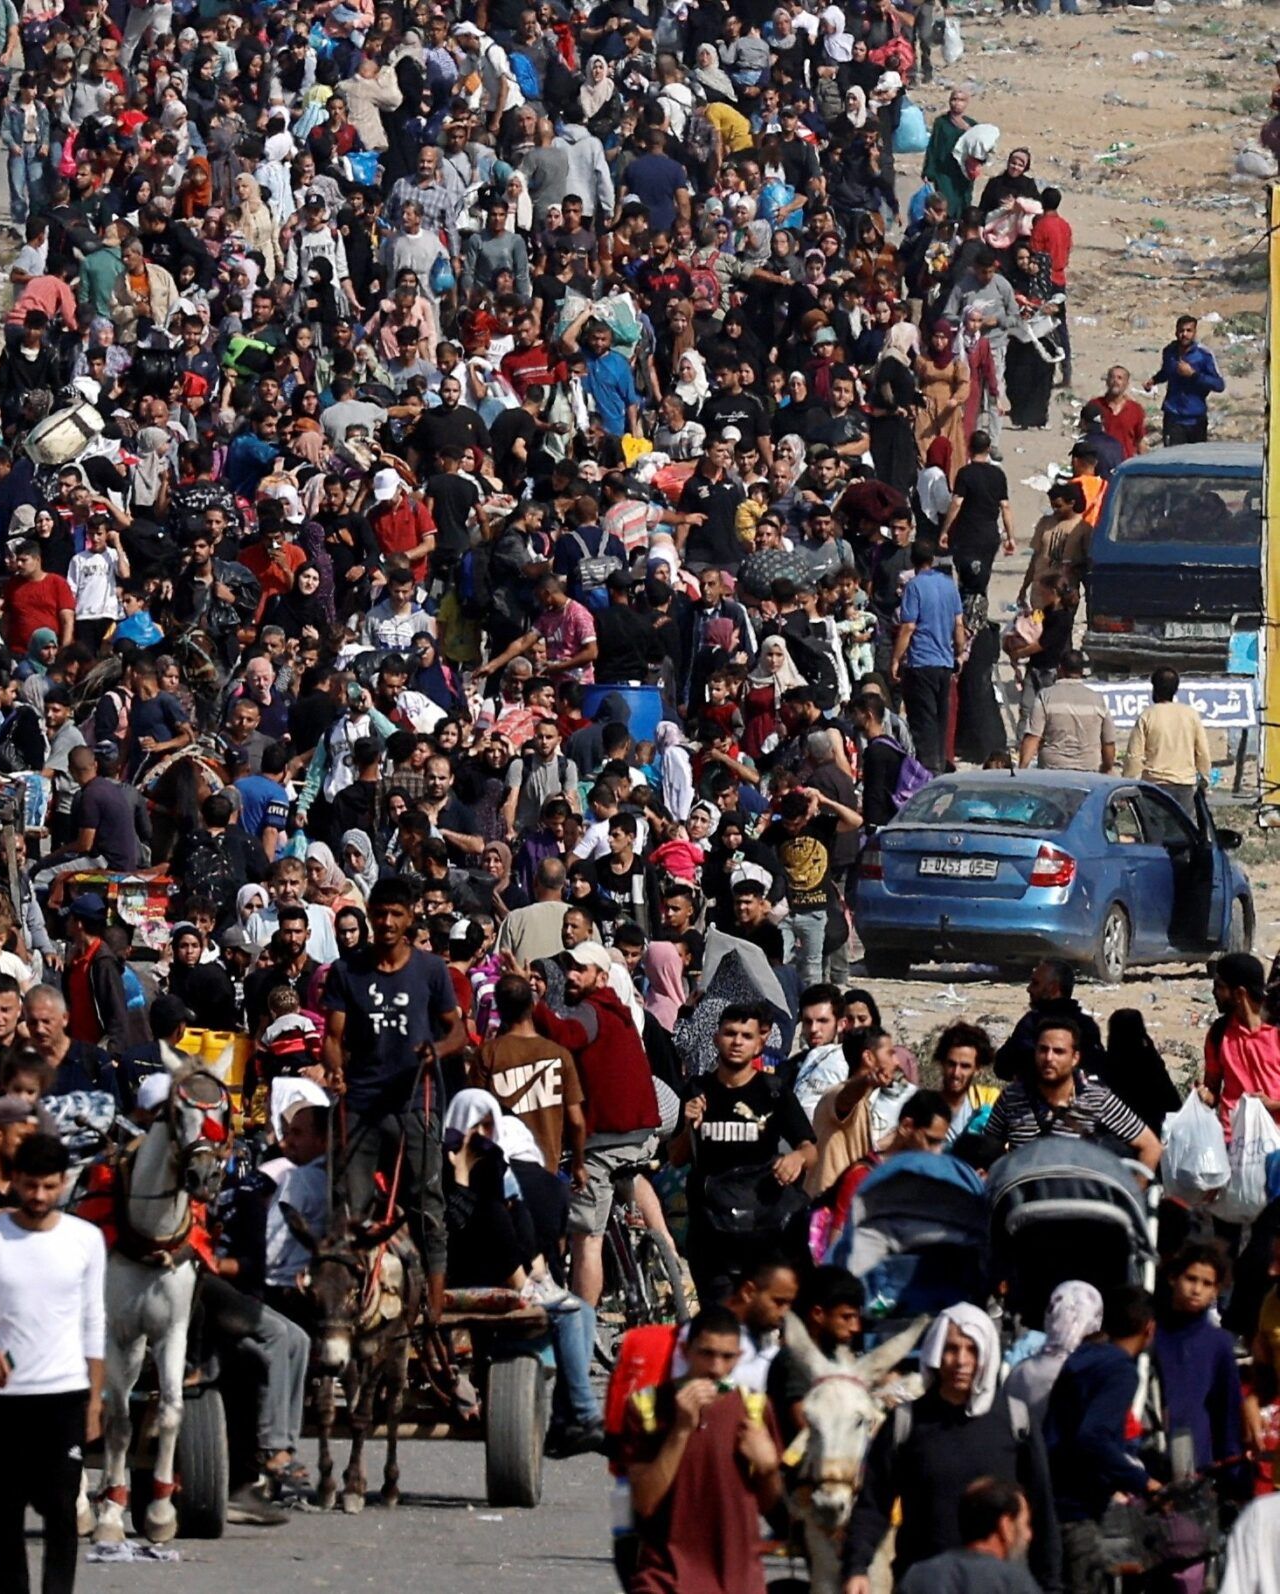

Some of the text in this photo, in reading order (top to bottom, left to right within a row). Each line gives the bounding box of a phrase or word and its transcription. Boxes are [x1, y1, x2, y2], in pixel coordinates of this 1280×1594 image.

[1103, 693, 1151, 718] LICE
[492, 1058, 562, 1115] NIKE
[701, 1121, 759, 1142] PUMA
